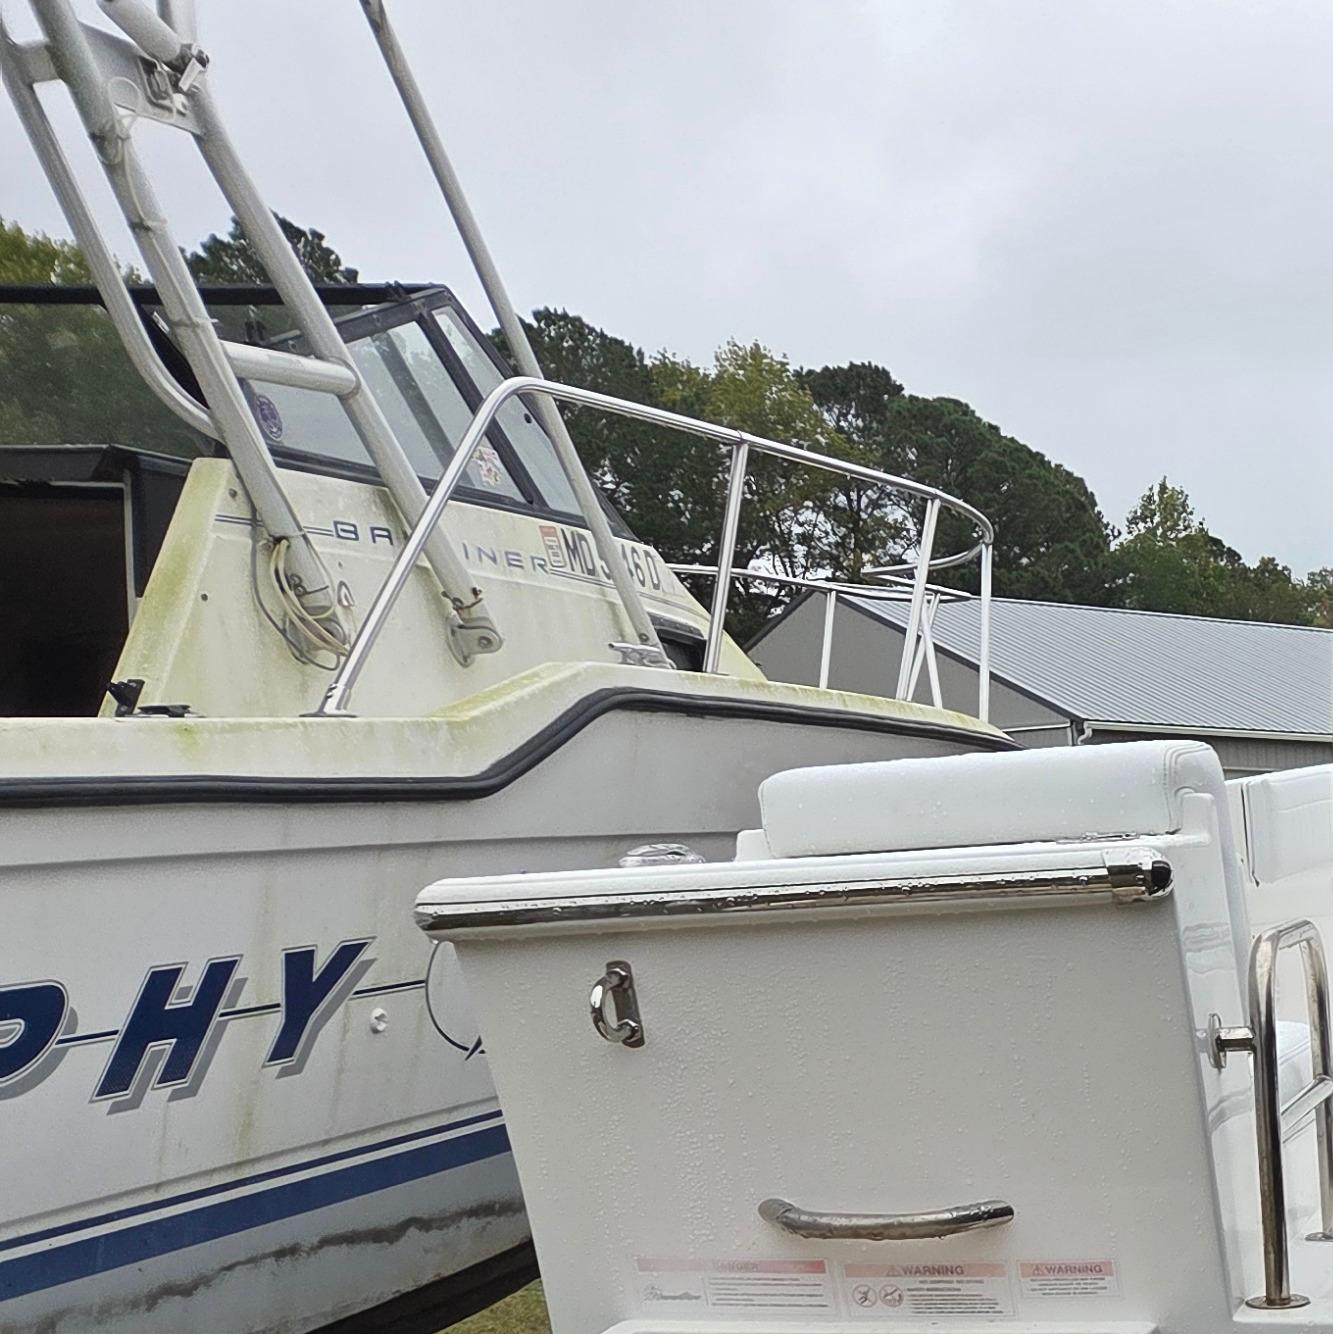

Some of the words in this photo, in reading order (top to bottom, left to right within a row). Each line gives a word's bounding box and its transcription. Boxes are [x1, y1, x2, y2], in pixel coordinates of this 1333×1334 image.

[333, 520, 550, 576] BAINER
[902, 1264, 965, 1276] WARNING
[1045, 1263, 1103, 1275] WARNING
